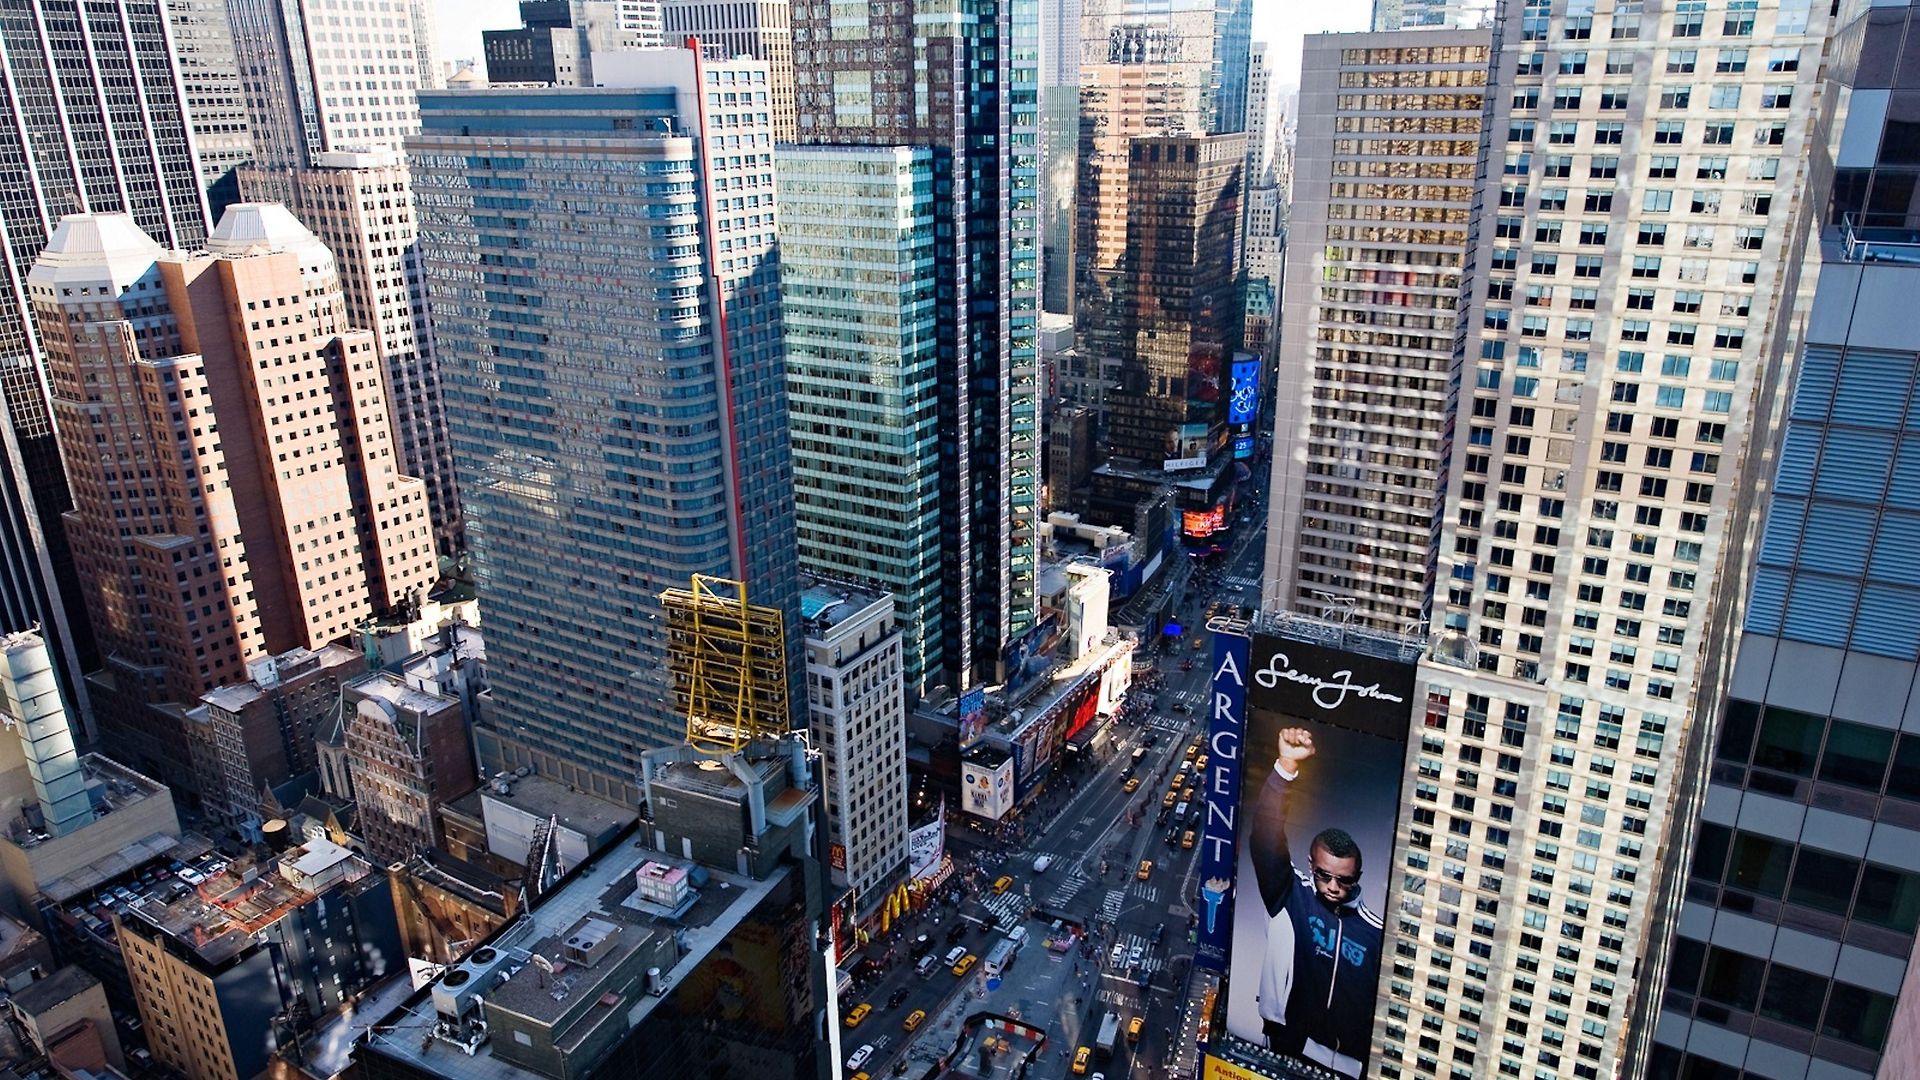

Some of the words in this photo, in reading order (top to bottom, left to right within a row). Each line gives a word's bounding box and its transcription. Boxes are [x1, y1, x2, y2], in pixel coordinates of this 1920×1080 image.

[1254, 653, 1322, 688] Sean
[1312, 670, 1403, 710] John
[1206, 651, 1244, 862] ARGENT
